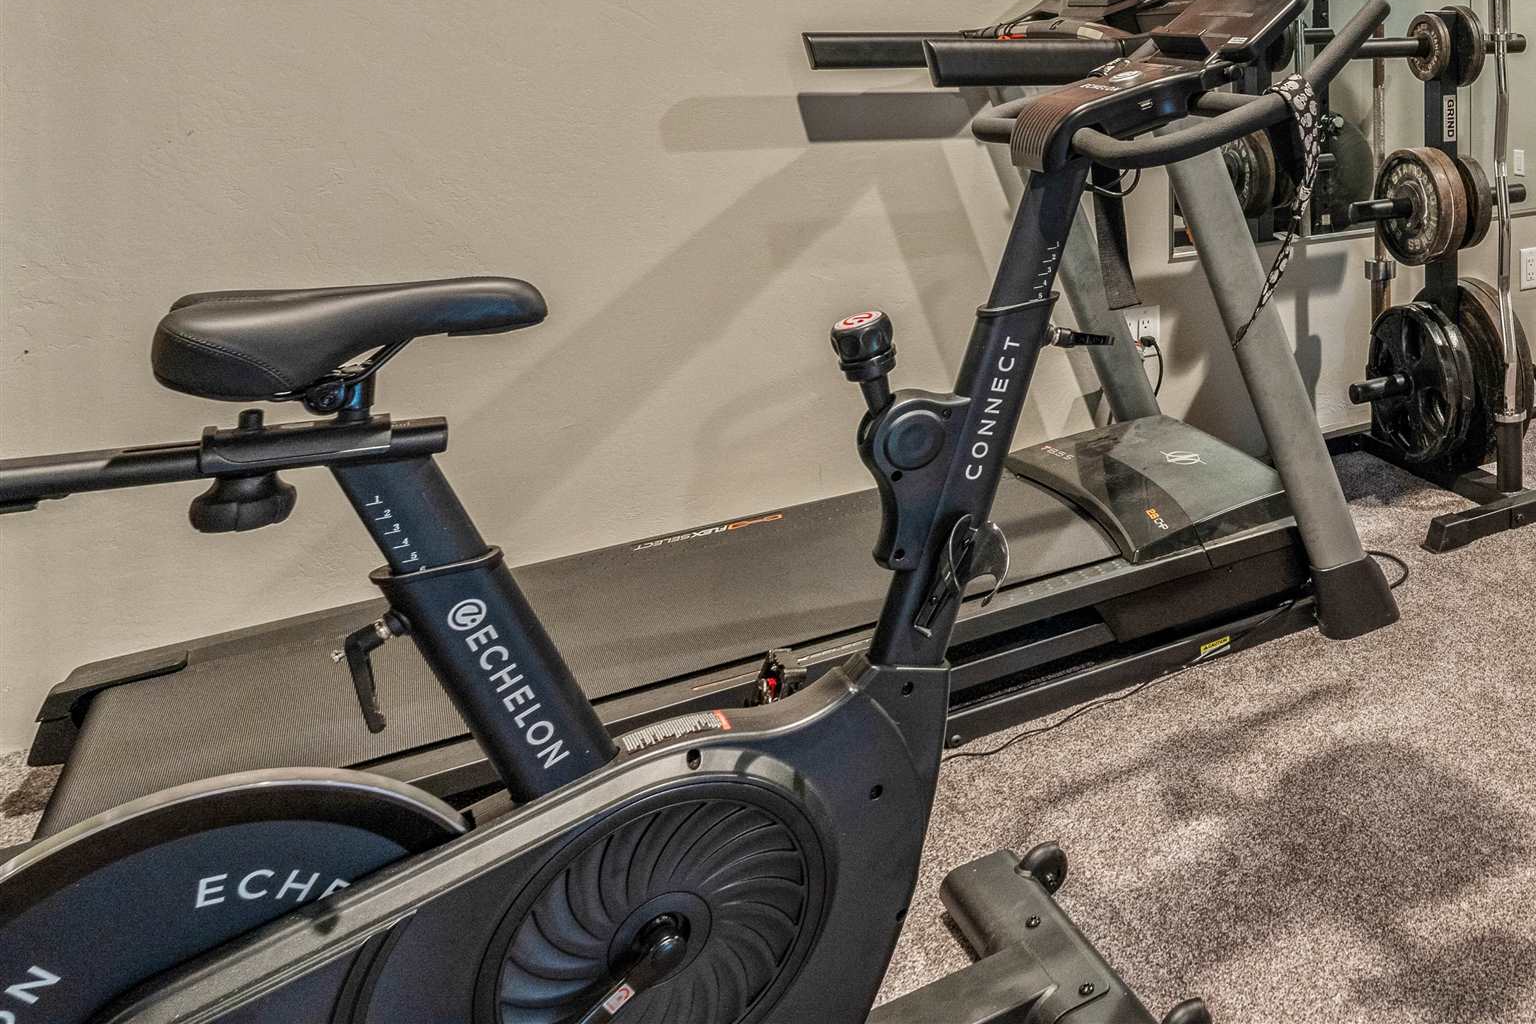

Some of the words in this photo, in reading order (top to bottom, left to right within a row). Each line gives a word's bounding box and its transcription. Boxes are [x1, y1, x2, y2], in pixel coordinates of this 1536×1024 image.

[1447, 98, 1455, 138] GRIND
[965, 336, 1020, 480] CONNECT
[465, 624, 570, 769] ECHELON
